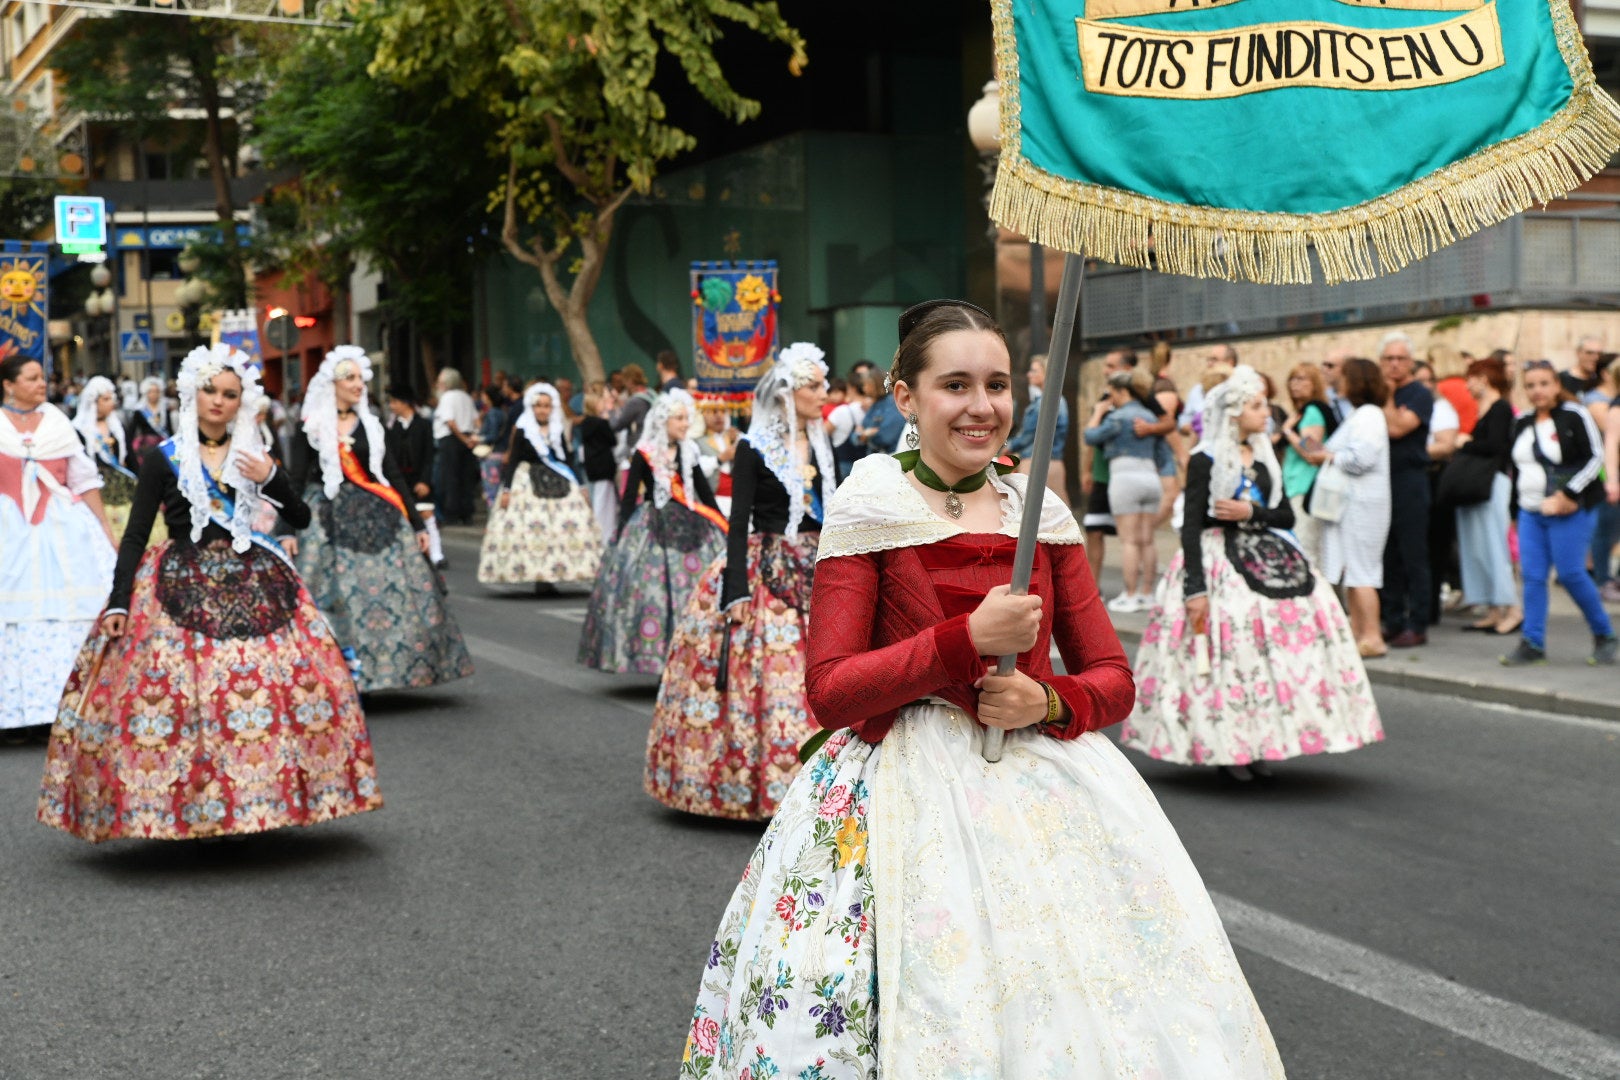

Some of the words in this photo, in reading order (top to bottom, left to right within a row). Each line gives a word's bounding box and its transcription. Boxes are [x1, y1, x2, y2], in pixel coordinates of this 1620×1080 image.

[1098, 32, 1194, 89] TOTS
[1206, 29, 1375, 91] FUNDITS
[1379, 32, 1444, 82] EN
[1440, 24, 1484, 66] U
